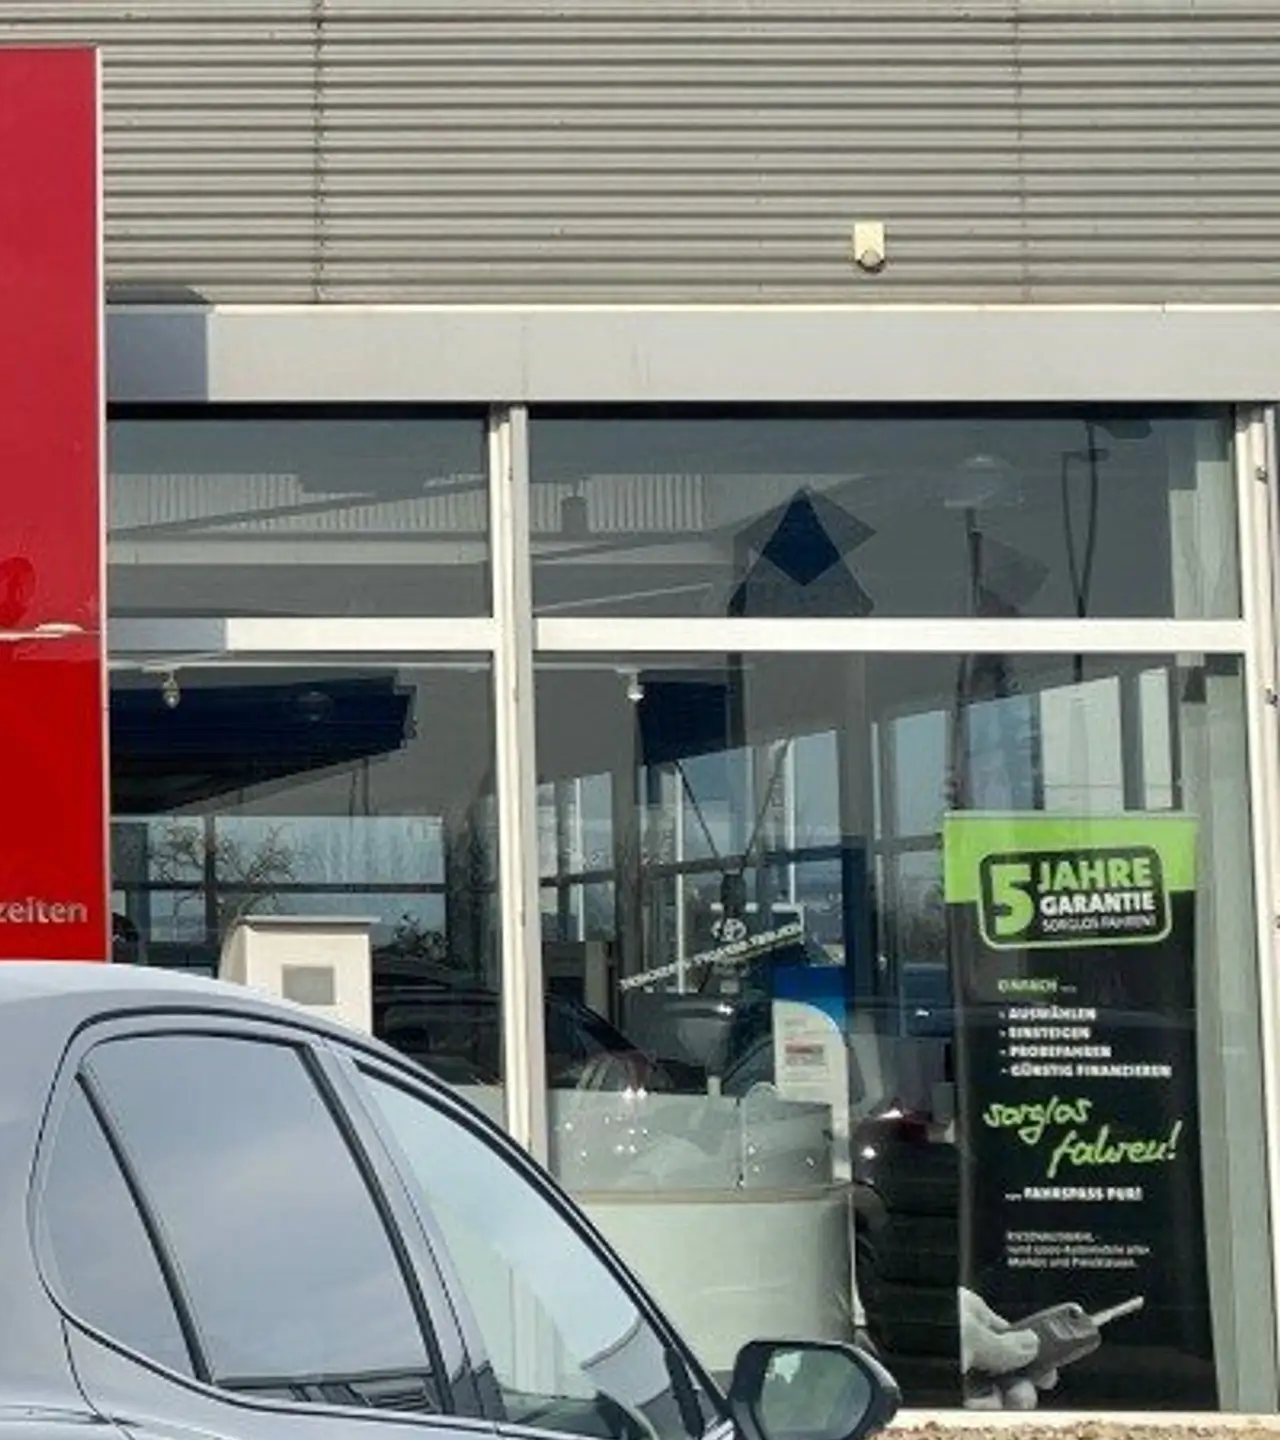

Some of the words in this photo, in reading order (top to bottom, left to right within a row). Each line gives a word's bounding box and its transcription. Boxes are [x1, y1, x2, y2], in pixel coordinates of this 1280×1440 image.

[991, 863, 1035, 936] 5
[1037, 857, 1154, 893] JAHRE
[1040, 891, 1156, 917] GARANTIE
[1007, 1005, 1097, 1022] AUSWÄHLEN
[1007, 1026, 1092, 1040] EINSTEIGEN
[1008, 1044, 1112, 1058] PROBEFAHREN
[1010, 1062, 1074, 1078] GÜNSTIG
[982, 1095, 1093, 1145] sorglos
[1023, 1186, 1105, 1201] FAHRSPASS
